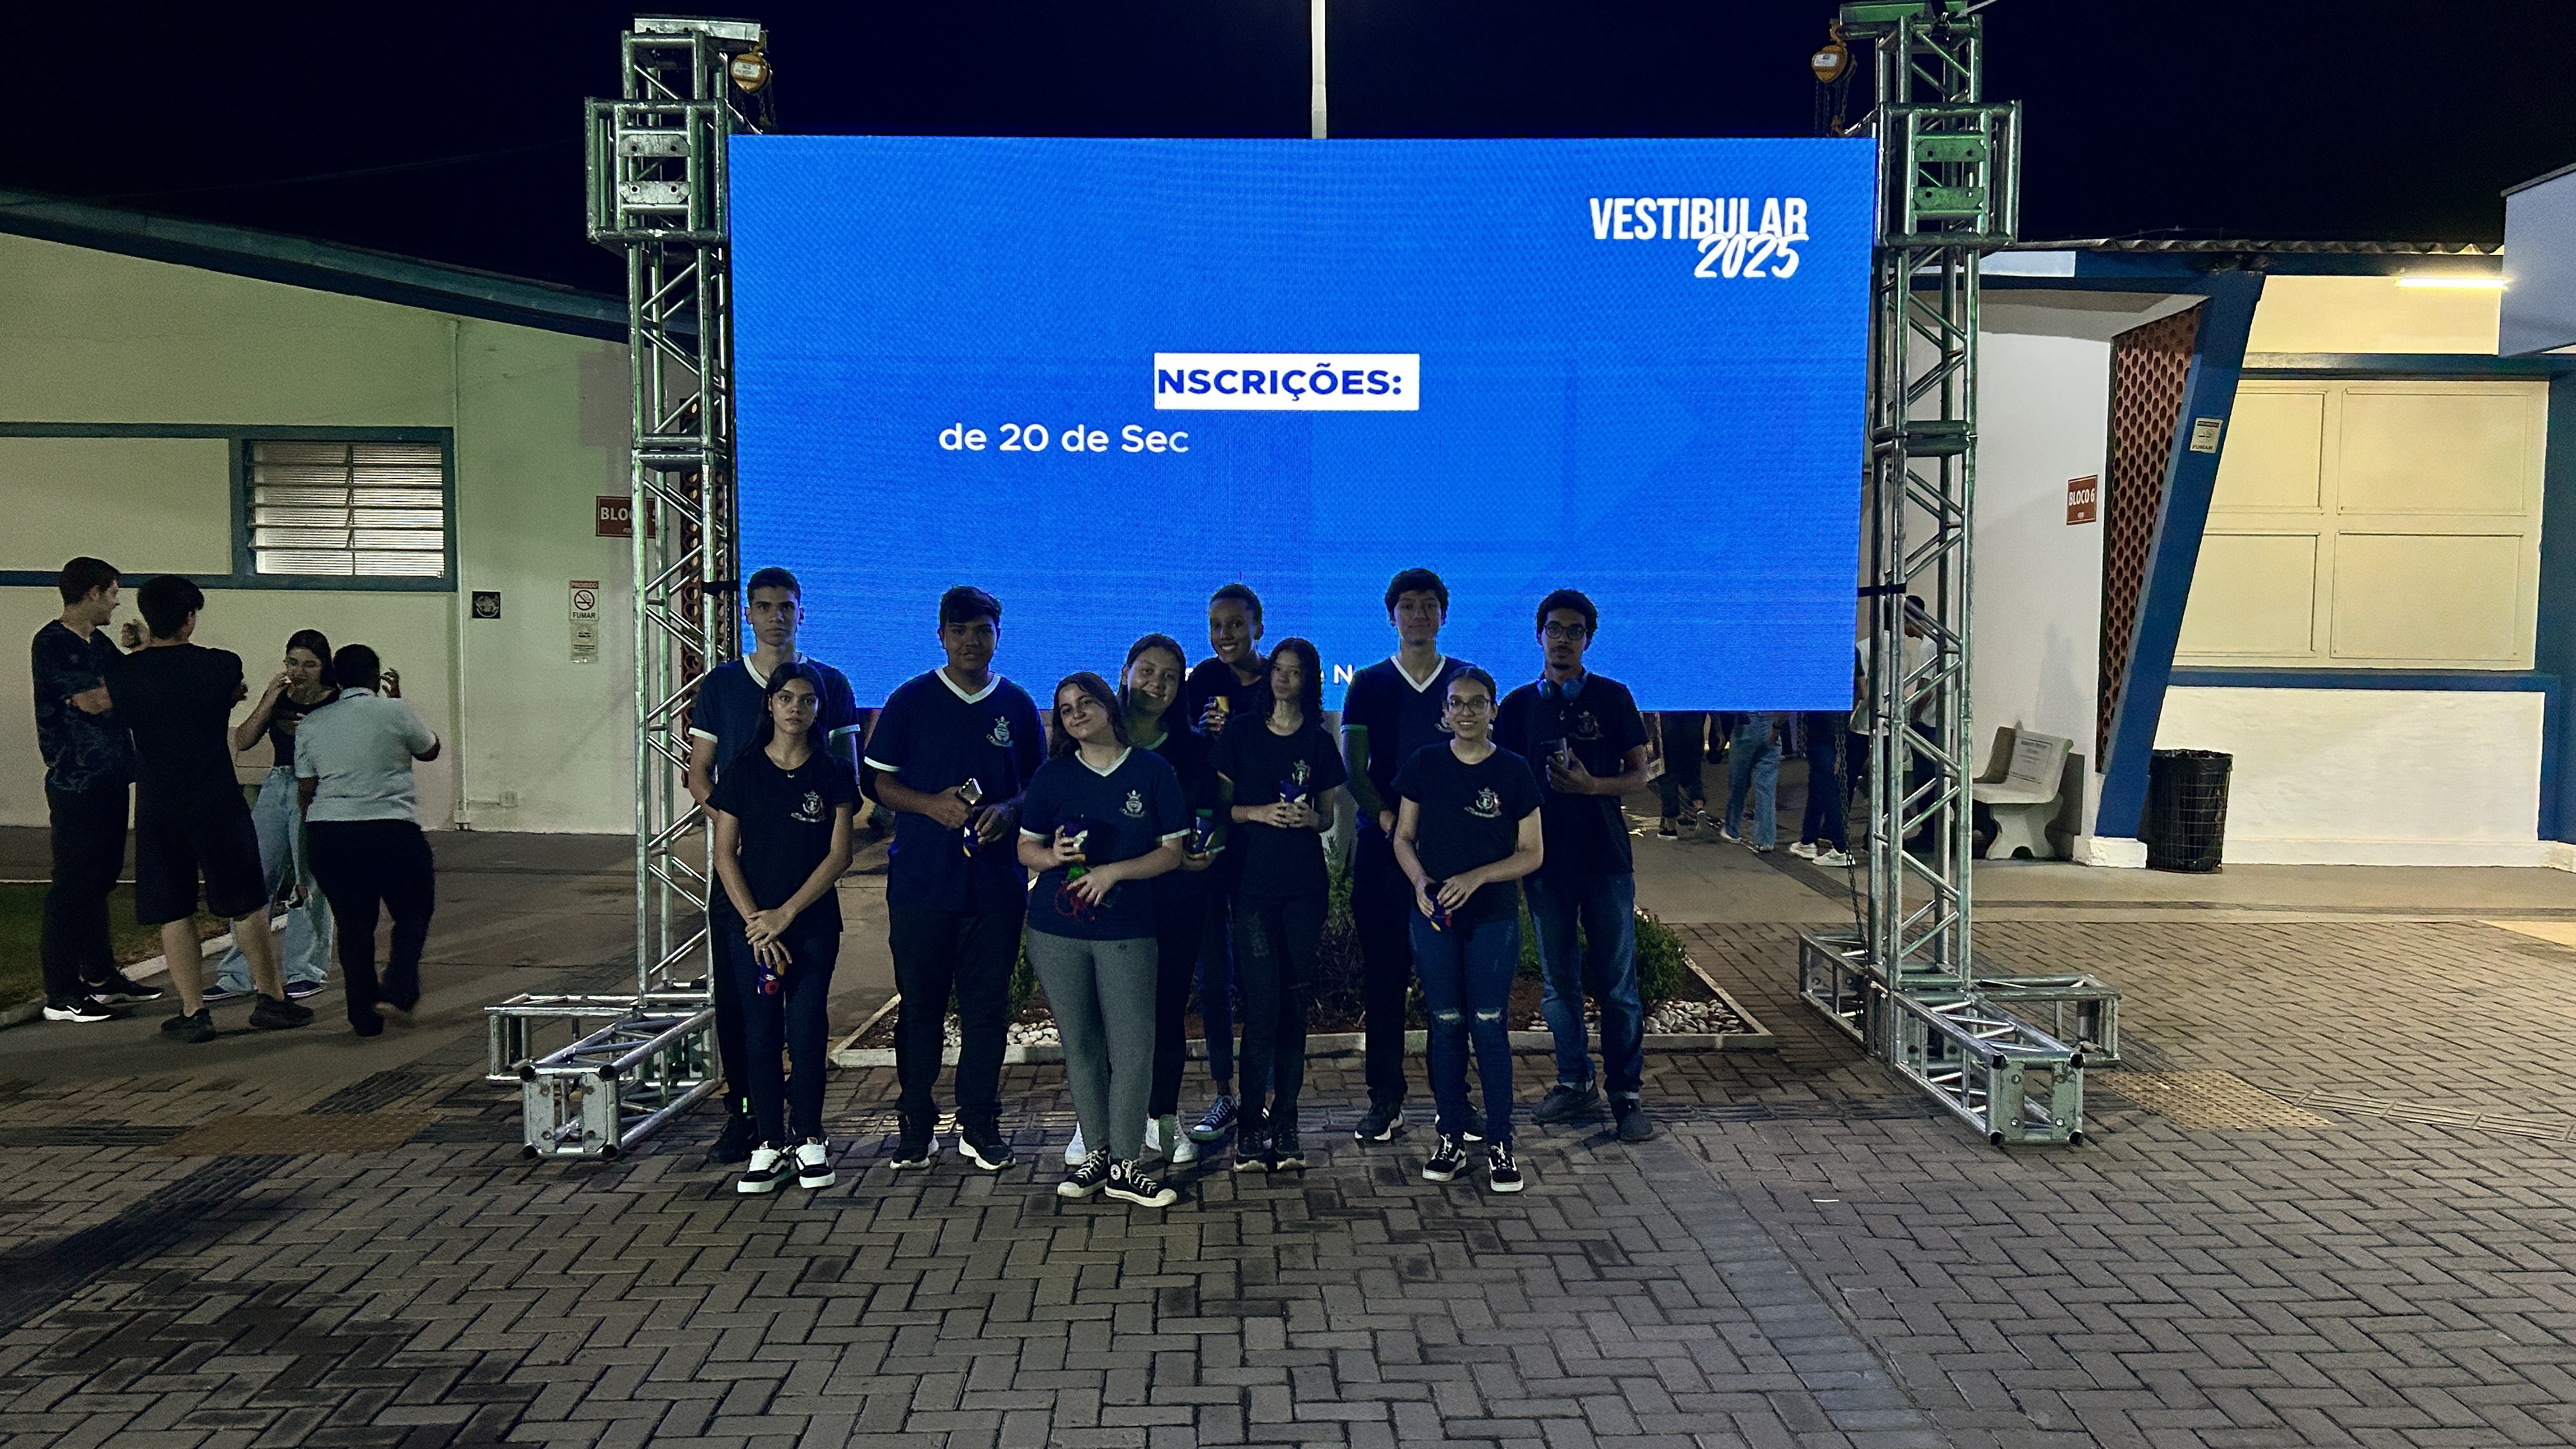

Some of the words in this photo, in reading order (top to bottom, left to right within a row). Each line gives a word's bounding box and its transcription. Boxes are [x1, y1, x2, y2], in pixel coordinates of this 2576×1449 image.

[1589, 197, 1808, 240] VESTIBULAR
[1694, 233, 1809, 279] 2025
[1158, 362, 1402, 402] NSCRIÇÕES:
[939, 422, 987, 451] de
[999, 423, 1048, 452] 20
[1061, 424, 1109, 452] de
[1121, 424, 1189, 453] Sec
[601, 507, 648, 521] BLO
[2069, 489, 2090, 506] BLOCO
[2090, 488, 2095, 503] 6
